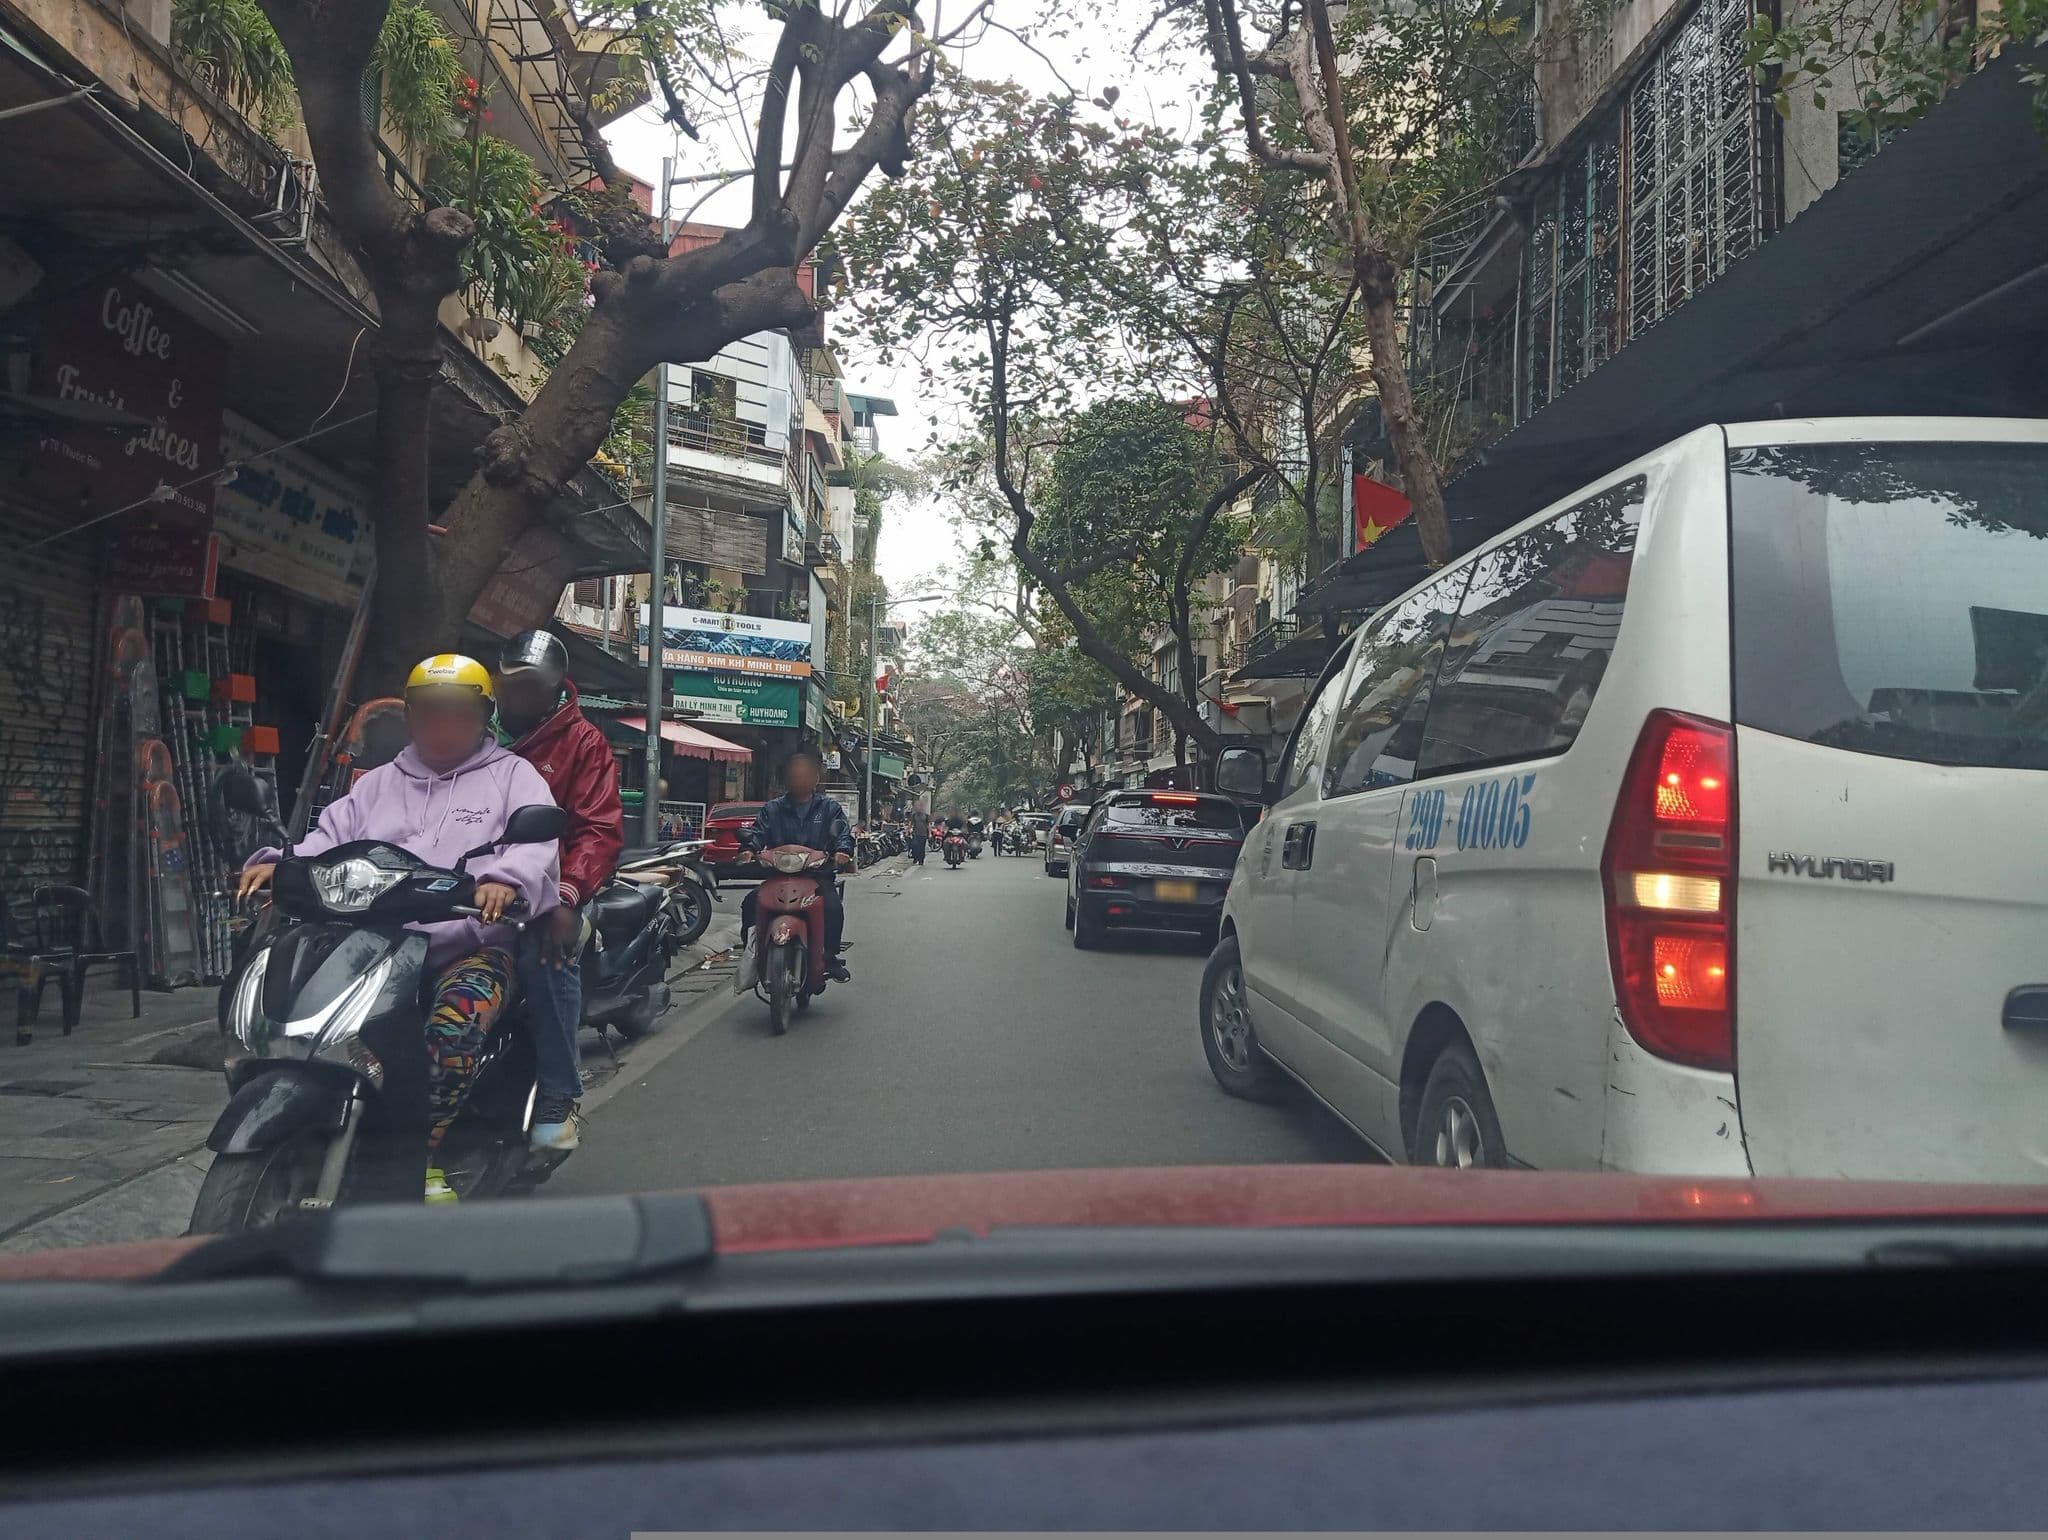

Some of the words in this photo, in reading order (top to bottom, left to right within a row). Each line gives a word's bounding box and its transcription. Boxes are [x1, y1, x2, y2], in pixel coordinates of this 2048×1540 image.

[102, 288, 170, 359] Coffee
[168, 377, 184, 409] &
[692, 617, 720, 626] C-MART
[736, 622, 762, 631] TOOLS
[707, 656, 726, 666] KIM
[729, 657, 745, 668] KHÍ
[747, 659, 772, 670] MINH
[775, 662, 792, 672] THU
[700, 702, 717, 711] MINH
[717, 703, 733, 712] THU
[1405, 789, 1445, 850] 29D
[1457, 772, 1536, 851] 010.05
[1768, 851, 1895, 883] HYUNDAI
